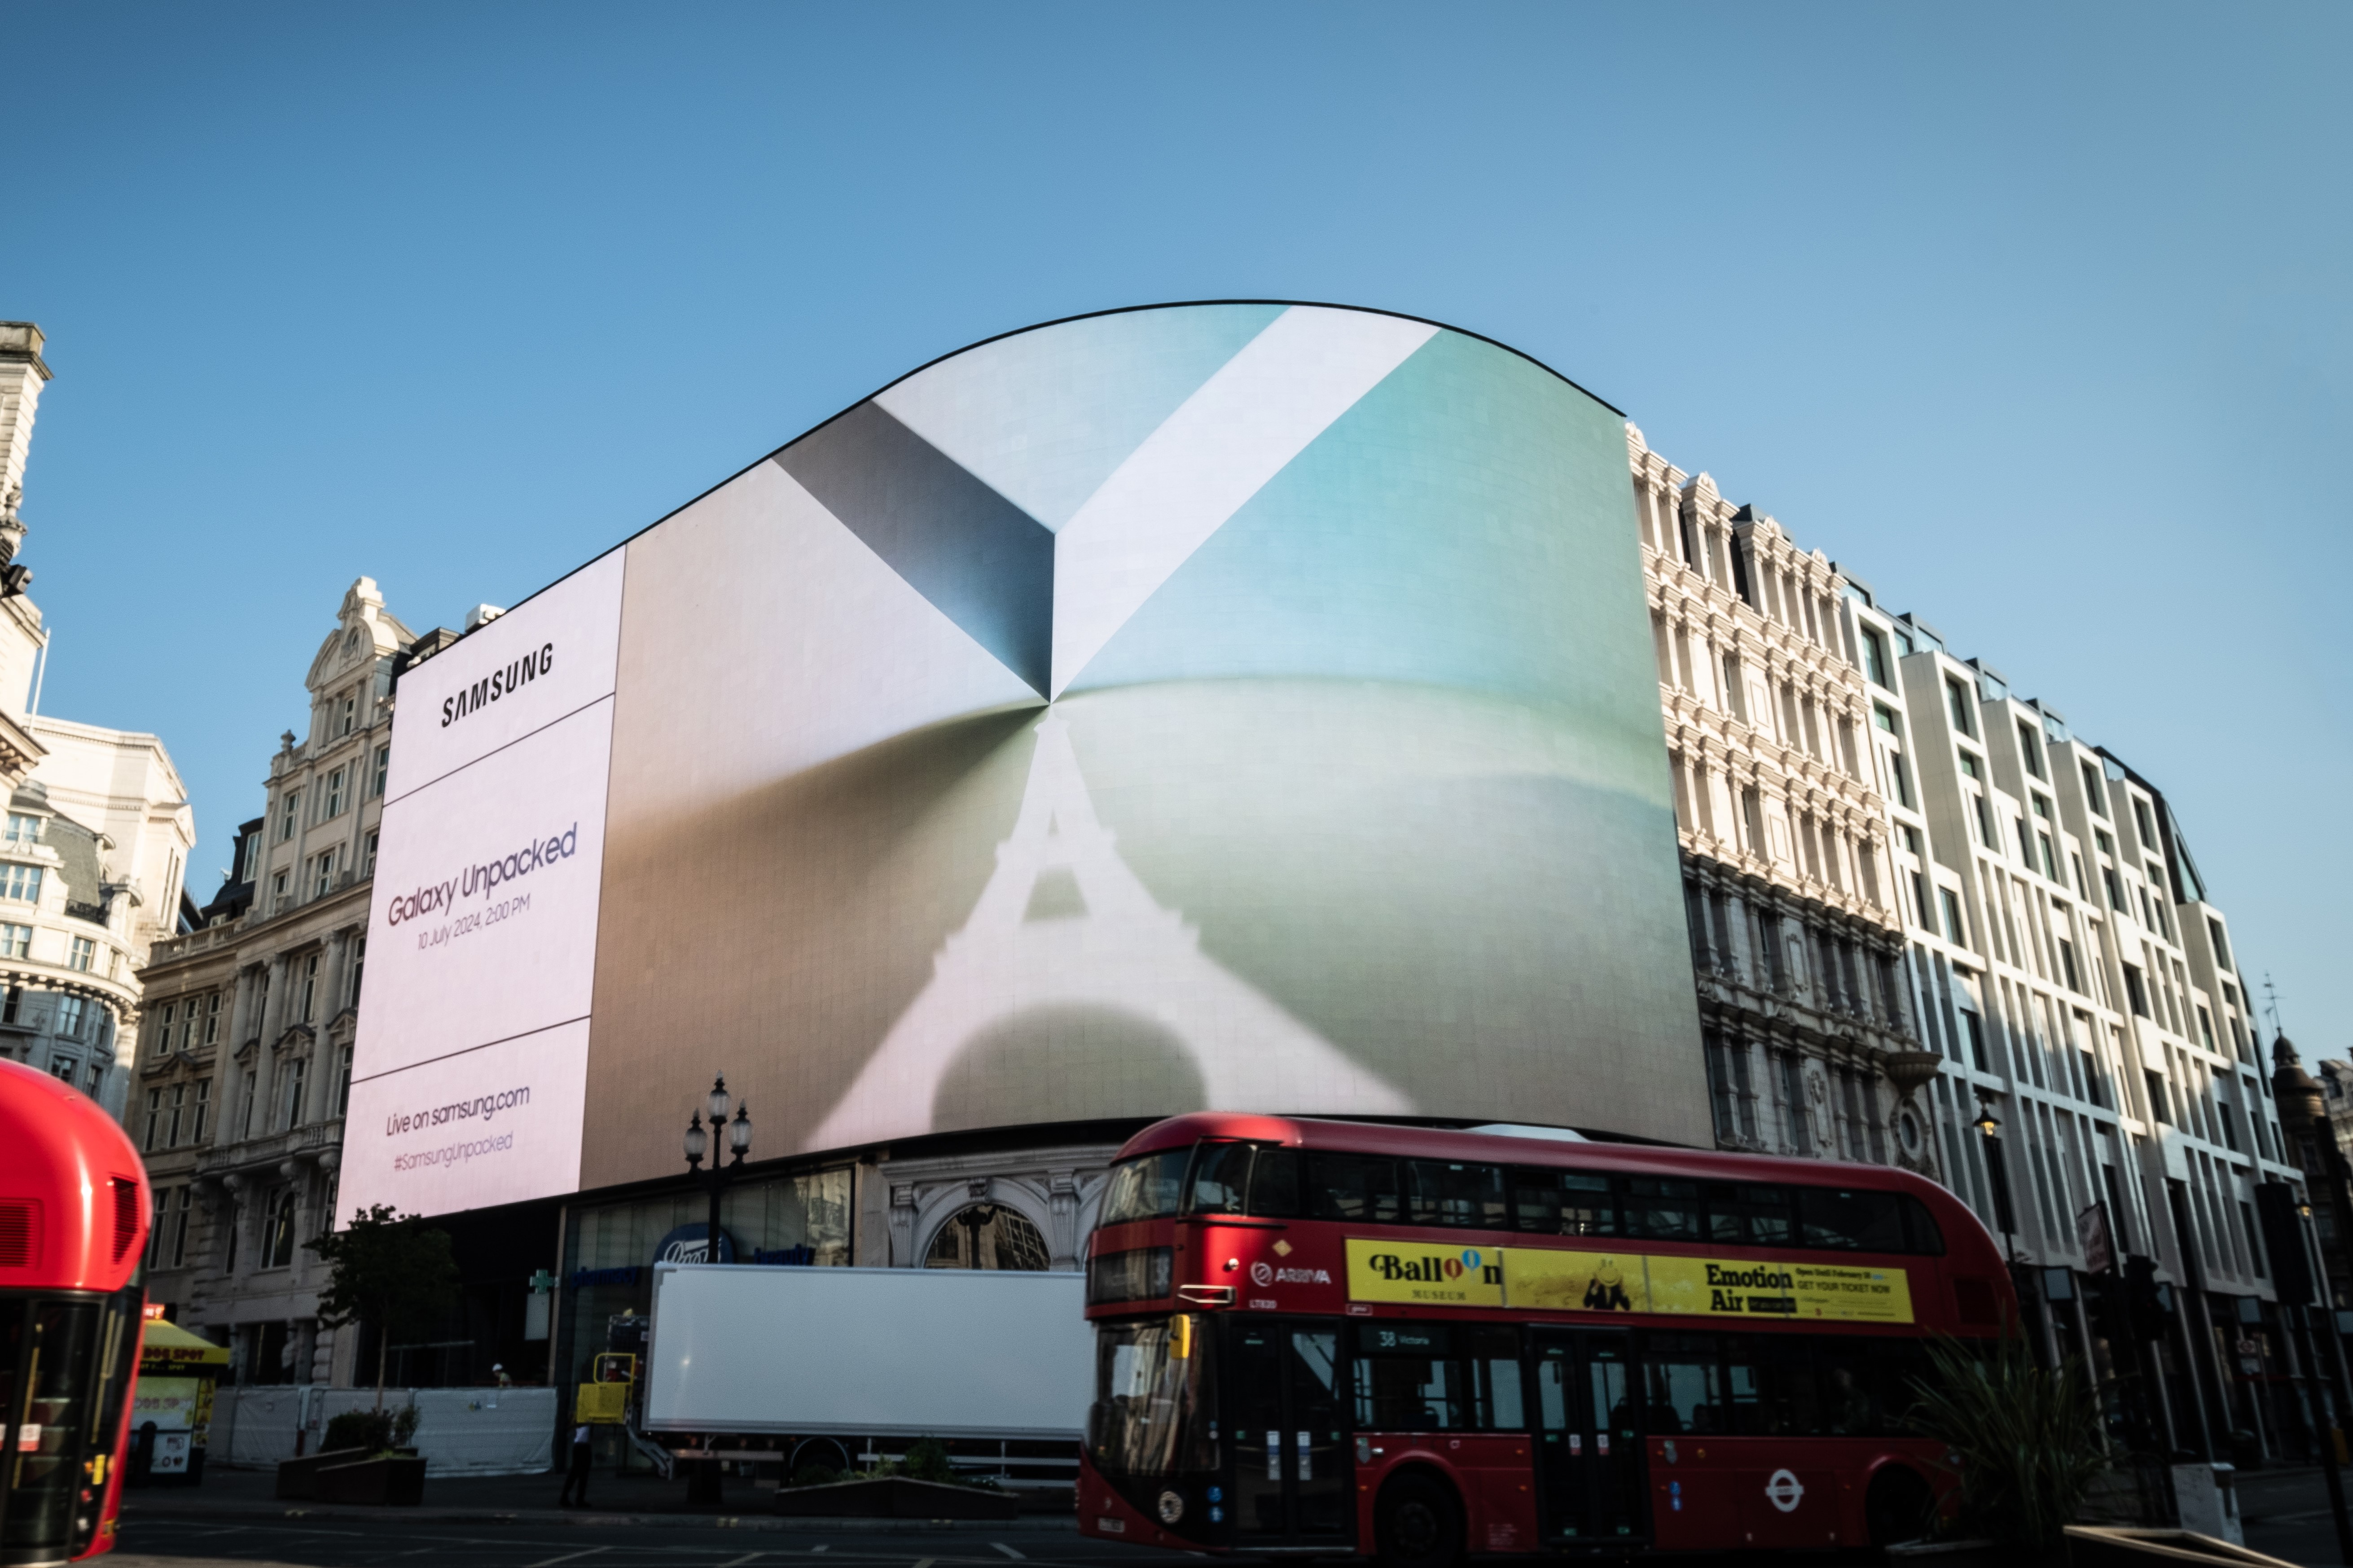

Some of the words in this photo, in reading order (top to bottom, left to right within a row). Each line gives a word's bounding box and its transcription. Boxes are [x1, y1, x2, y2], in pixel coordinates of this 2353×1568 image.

[441, 643, 553, 727] SAMSUNG
[388, 877, 458, 926] Galaxy
[462, 821, 577, 900] Unpacked
[418, 932, 428, 950] 10
[430, 924, 452, 947] July
[453, 911, 483, 937] 2024,
[485, 901, 509, 926] 2:00
[511, 892, 531, 915] PM
[386, 1112, 410, 1136] Live
[413, 1109, 429, 1130] on
[431, 1086, 530, 1121] samsung.com
[394, 1130, 514, 1171] #SamsungUnpacked
[571, 1266, 638, 1291] pharmacy
[1275, 1267, 1332, 1284] ARRIVA
[1705, 1263, 1794, 1289] Emotion
[1797, 1280, 1814, 1290] GET
[1412, 1289, 1466, 1300] MUSEUM
[1710, 1289, 1743, 1312] Air
[173, 1349, 205, 1361] SPOT
